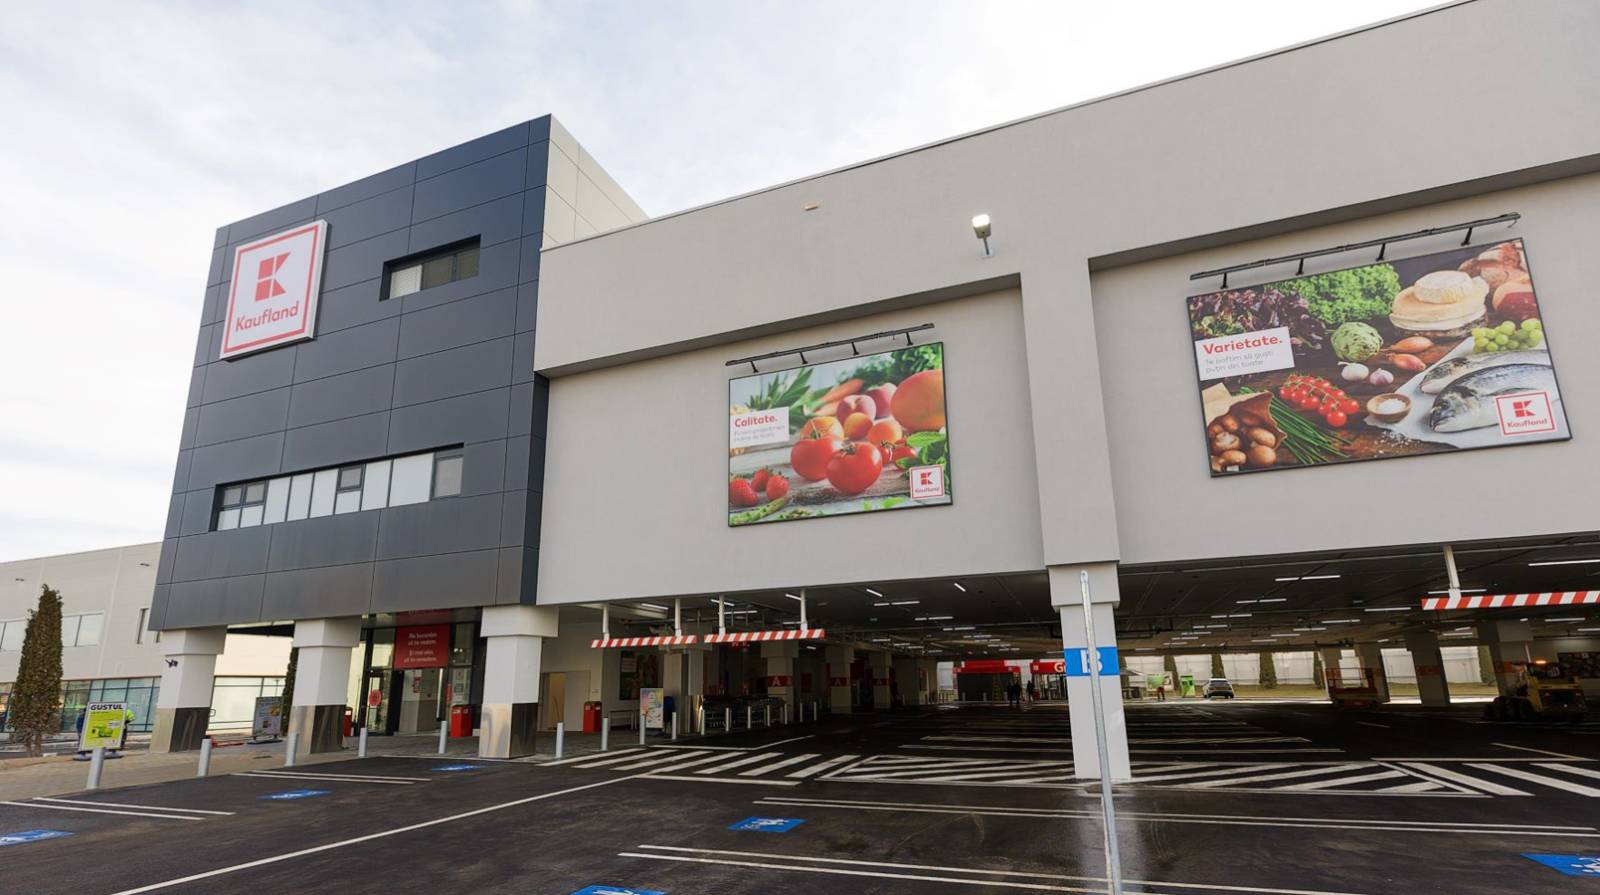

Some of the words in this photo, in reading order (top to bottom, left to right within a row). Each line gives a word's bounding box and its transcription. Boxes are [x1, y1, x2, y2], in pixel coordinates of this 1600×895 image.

[235, 300, 299, 332] Kaufland
[1203, 336, 1283, 354] Varietate.
[735, 415, 778, 427] Calitate.
[90, 703, 124, 711] GUSTUL
